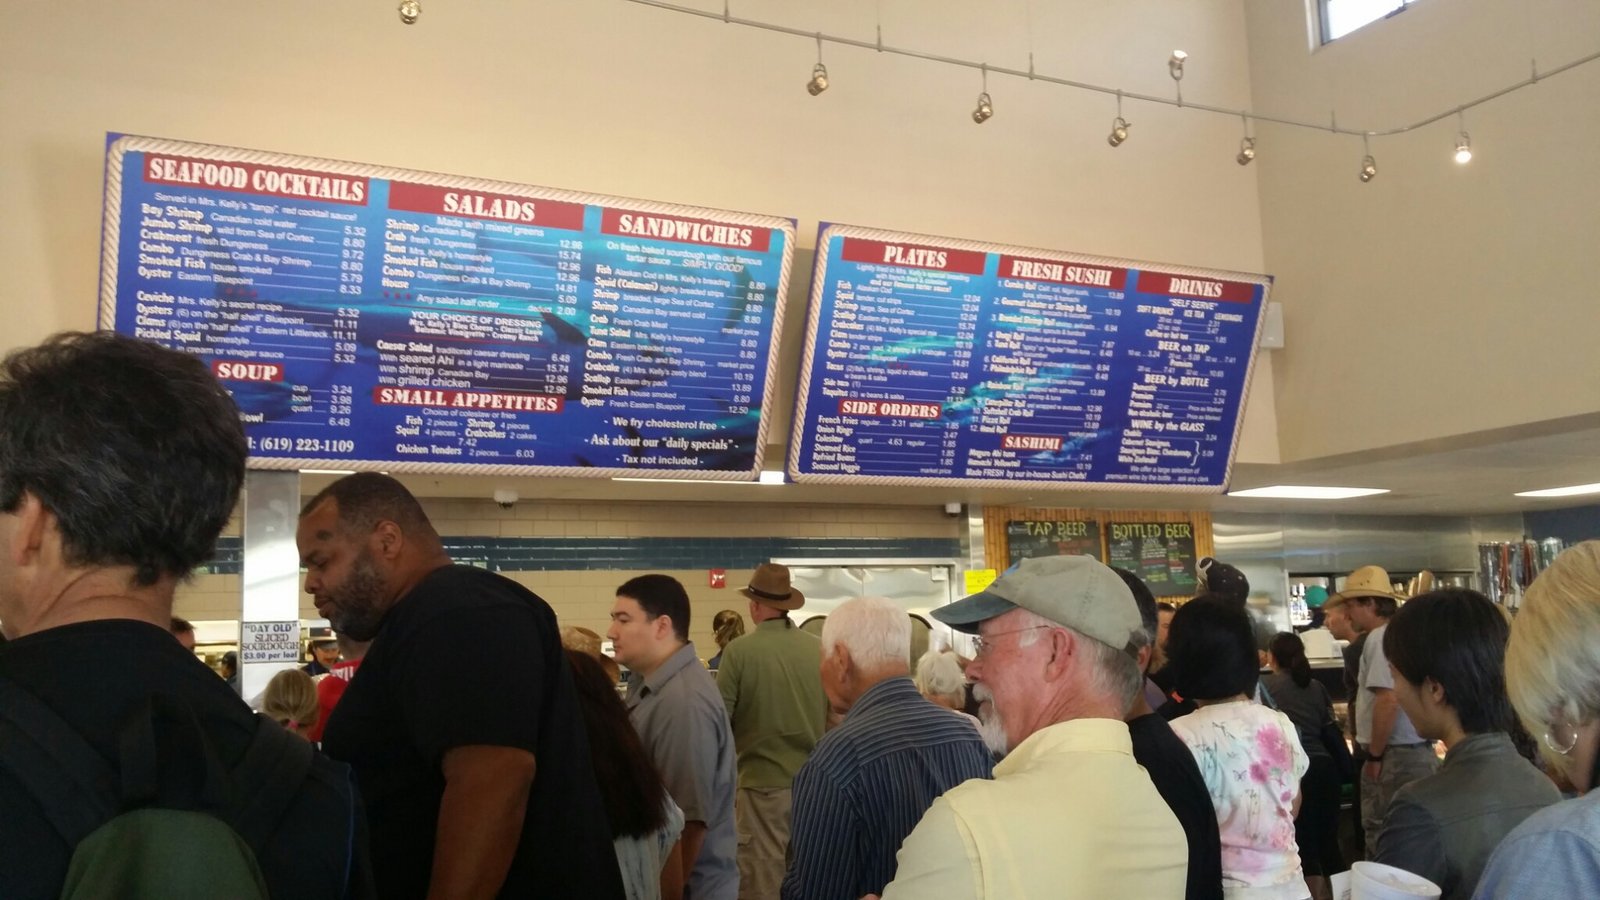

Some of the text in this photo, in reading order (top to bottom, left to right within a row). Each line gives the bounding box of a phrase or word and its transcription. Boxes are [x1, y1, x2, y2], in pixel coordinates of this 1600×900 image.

[150, 158, 364, 202] SEAFOOD COCKTAILS
[443, 193, 535, 222] SALADS
[141, 218, 212, 234] Jumbo Shrimp
[142, 203, 366, 236] Bay Shrimp Canadian 5.32
[386, 218, 420, 233] Shrimp
[437, 217, 544, 236] Made with mixed greens
[619, 214, 752, 247] SANDWICHES
[140, 229, 192, 243] Crabmeat
[385, 230, 407, 241] Crab
[140, 242, 253, 262] Combo Crab
[385, 242, 407, 253] Tuna
[384, 254, 438, 268] Smoked Fish
[883, 245, 947, 268] PLATES
[139, 254, 237, 273] Smoked Fish house
[596, 264, 612, 275] Fish
[138, 267, 172, 280] Oyster
[383, 266, 415, 278] Combo
[1011, 260, 1112, 286] FRESH SUSHI
[595, 277, 616, 288] Squid
[837, 280, 852, 289] Fish
[1169, 278, 1223, 297] DRINKS
[435, 296, 458, 306] salad
[593, 289, 620, 301] Shrimp
[137, 291, 359, 318] Ceviche 5.32
[137, 304, 357, 329] Oysters 11.11
[411, 311, 542, 328] YOUR CHOICE OF DRESSING
[136, 327, 201, 342] Pickled Squid
[137, 316, 356, 340] Clams Eastern 11.11
[408, 342, 530, 361] Salad dressing
[1158, 341, 1210, 353] BEER on TAP
[334, 354, 355, 364] 5.32
[380, 354, 568, 373] With seared Ahi 15.74
[218, 363, 278, 380] SOUP
[379, 364, 568, 383] With shrimp Canadian Bay 12.96
[379, 375, 470, 388] With grilled chicken
[1145, 374, 1209, 387] BEER by BOTTLE
[292, 385, 352, 395] cup 3.24
[582, 385, 628, 396] Smoked Fish
[292, 394, 311, 402] bowl
[381, 388, 558, 411] SMALL APPETITES
[581, 397, 605, 407] Oyster
[291, 404, 351, 414] quart 9.26
[423, 407, 448, 416] Choice
[842, 401, 938, 417] SIDE ORDERS
[329, 417, 350, 427] 6.48
[406, 415, 530, 430] Fish 2 pieces Shrimp 4 pieces
[612, 417, 717, 430] We fry cholesterol free
[818, 415, 841, 424] French
[842, 417, 858, 425] Fries
[1131, 419, 1204, 432] WINE by the GLASS
[396, 425, 419, 437] Squid
[431, 429, 456, 438] pieces
[516, 432, 537, 440] cakes
[817, 425, 853, 435] Onion Rings
[260, 437, 292, 451] (619)
[296, 439, 354, 452] 223-1109
[458, 438, 477, 446] 7.42
[591, 434, 733, 451] Ask about our "daily specials"
[814, 443, 840, 453] Steamed
[888, 438, 902, 446] 4.63
[943, 440, 956, 448] 1.85
[1005, 436, 1060, 449] SASHIMI
[396, 444, 534, 458] Chicken Tenders 6.03
[813, 452, 855, 462] Refried Beans
[622, 454, 698, 465] Tax not included
[1025, 522, 1087, 536] TAP BEER
[1113, 524, 1191, 539] BOTTLED BEER
[244, 624, 296, 633] "DAY OLD"
[255, 633, 289, 642] SLICED
[242, 642, 299, 651] SOURDOUGH
[268, 653, 280, 661] per
